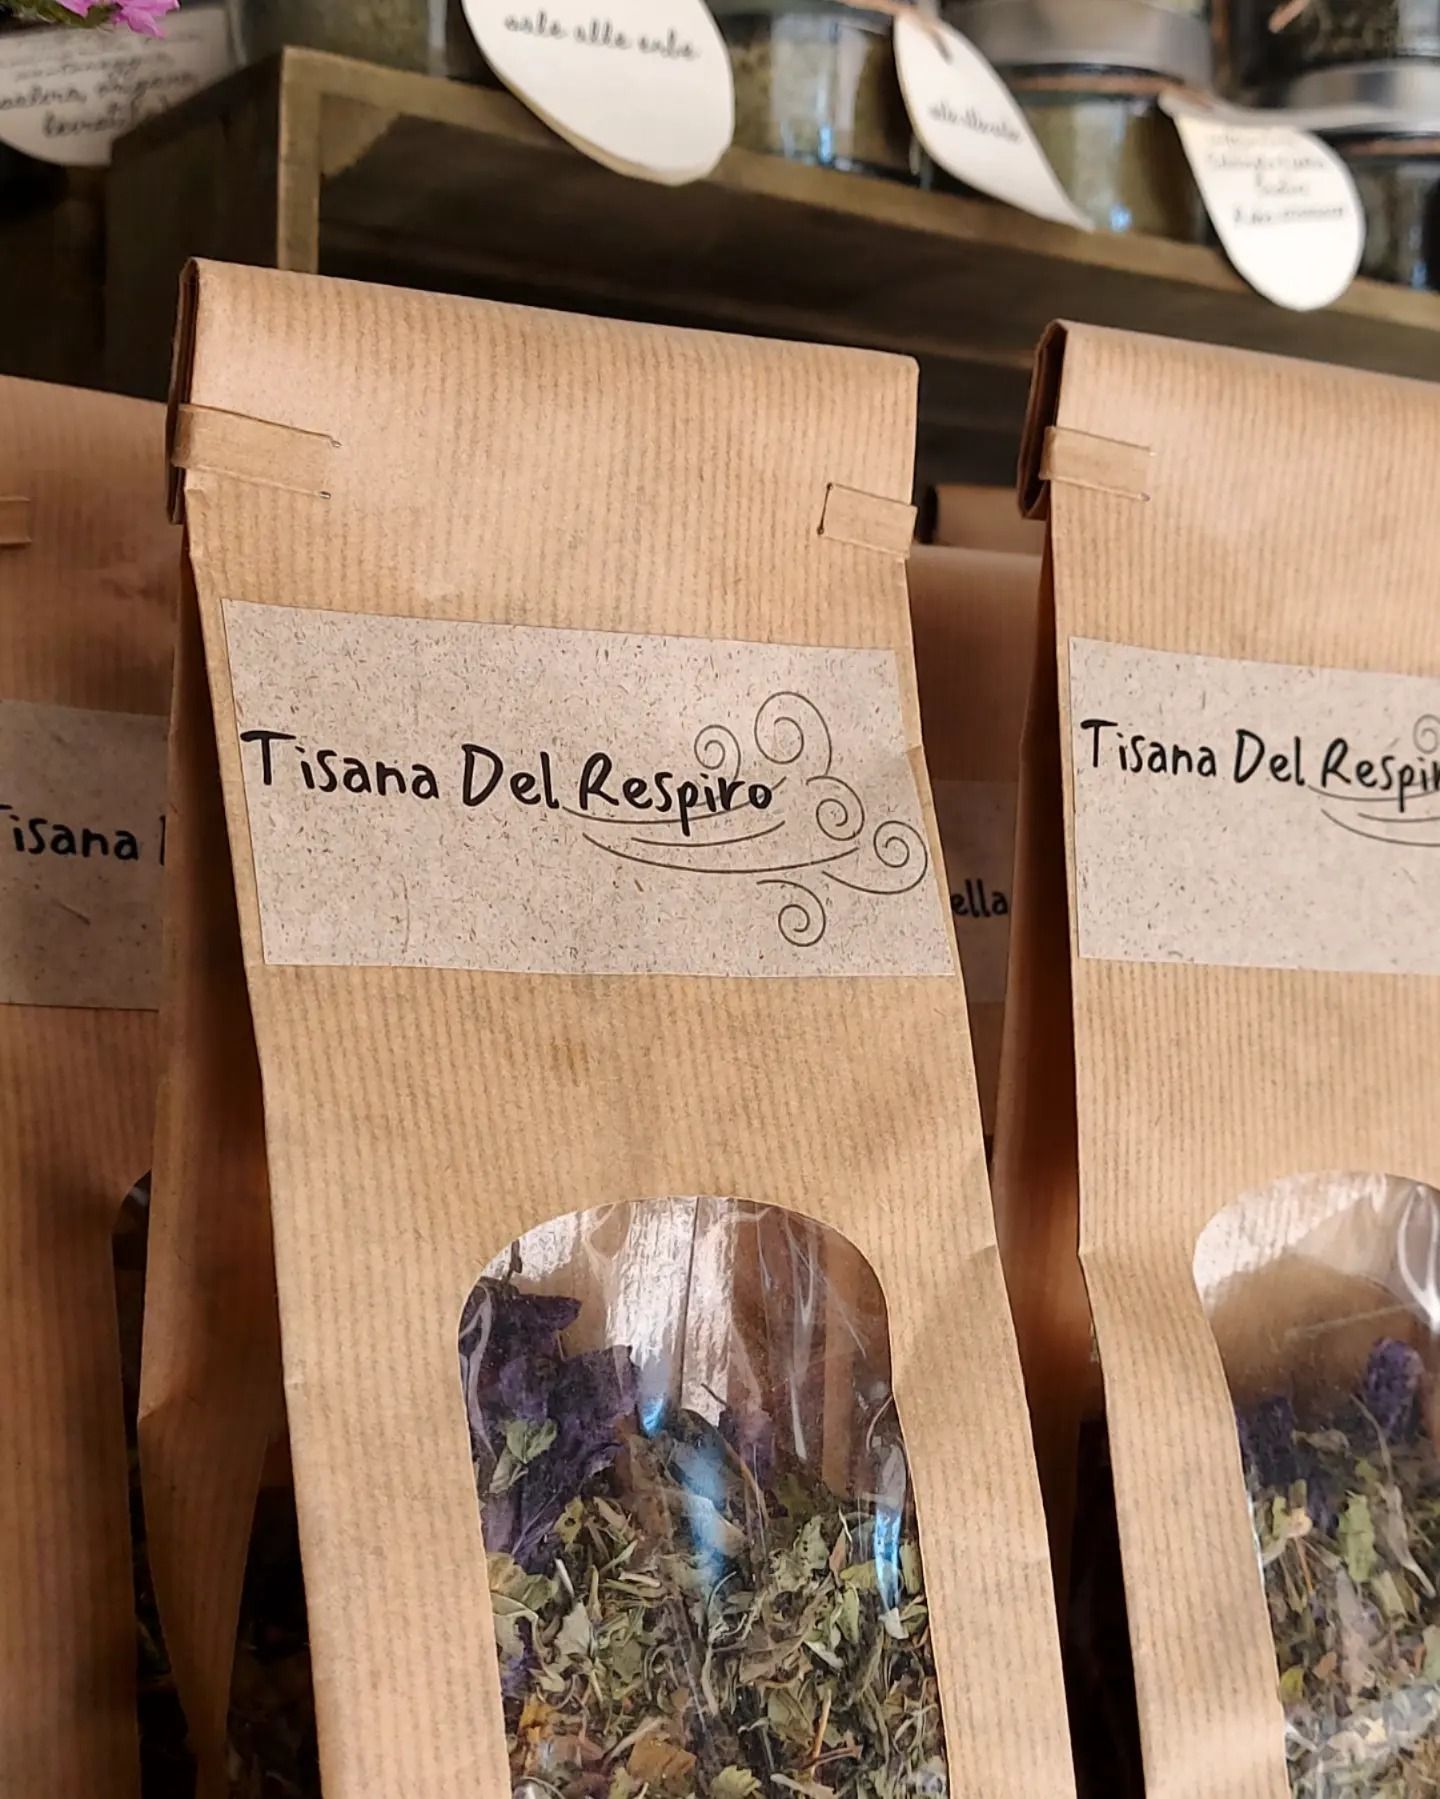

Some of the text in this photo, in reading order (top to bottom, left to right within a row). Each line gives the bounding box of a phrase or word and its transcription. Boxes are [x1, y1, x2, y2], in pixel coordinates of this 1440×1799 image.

[239, 730, 773, 837] Tisana Del Respiro
[1081, 718, 1217, 777] Tisana
[1234, 729, 1306, 786] Del
[0, 804, 139, 861] isana
